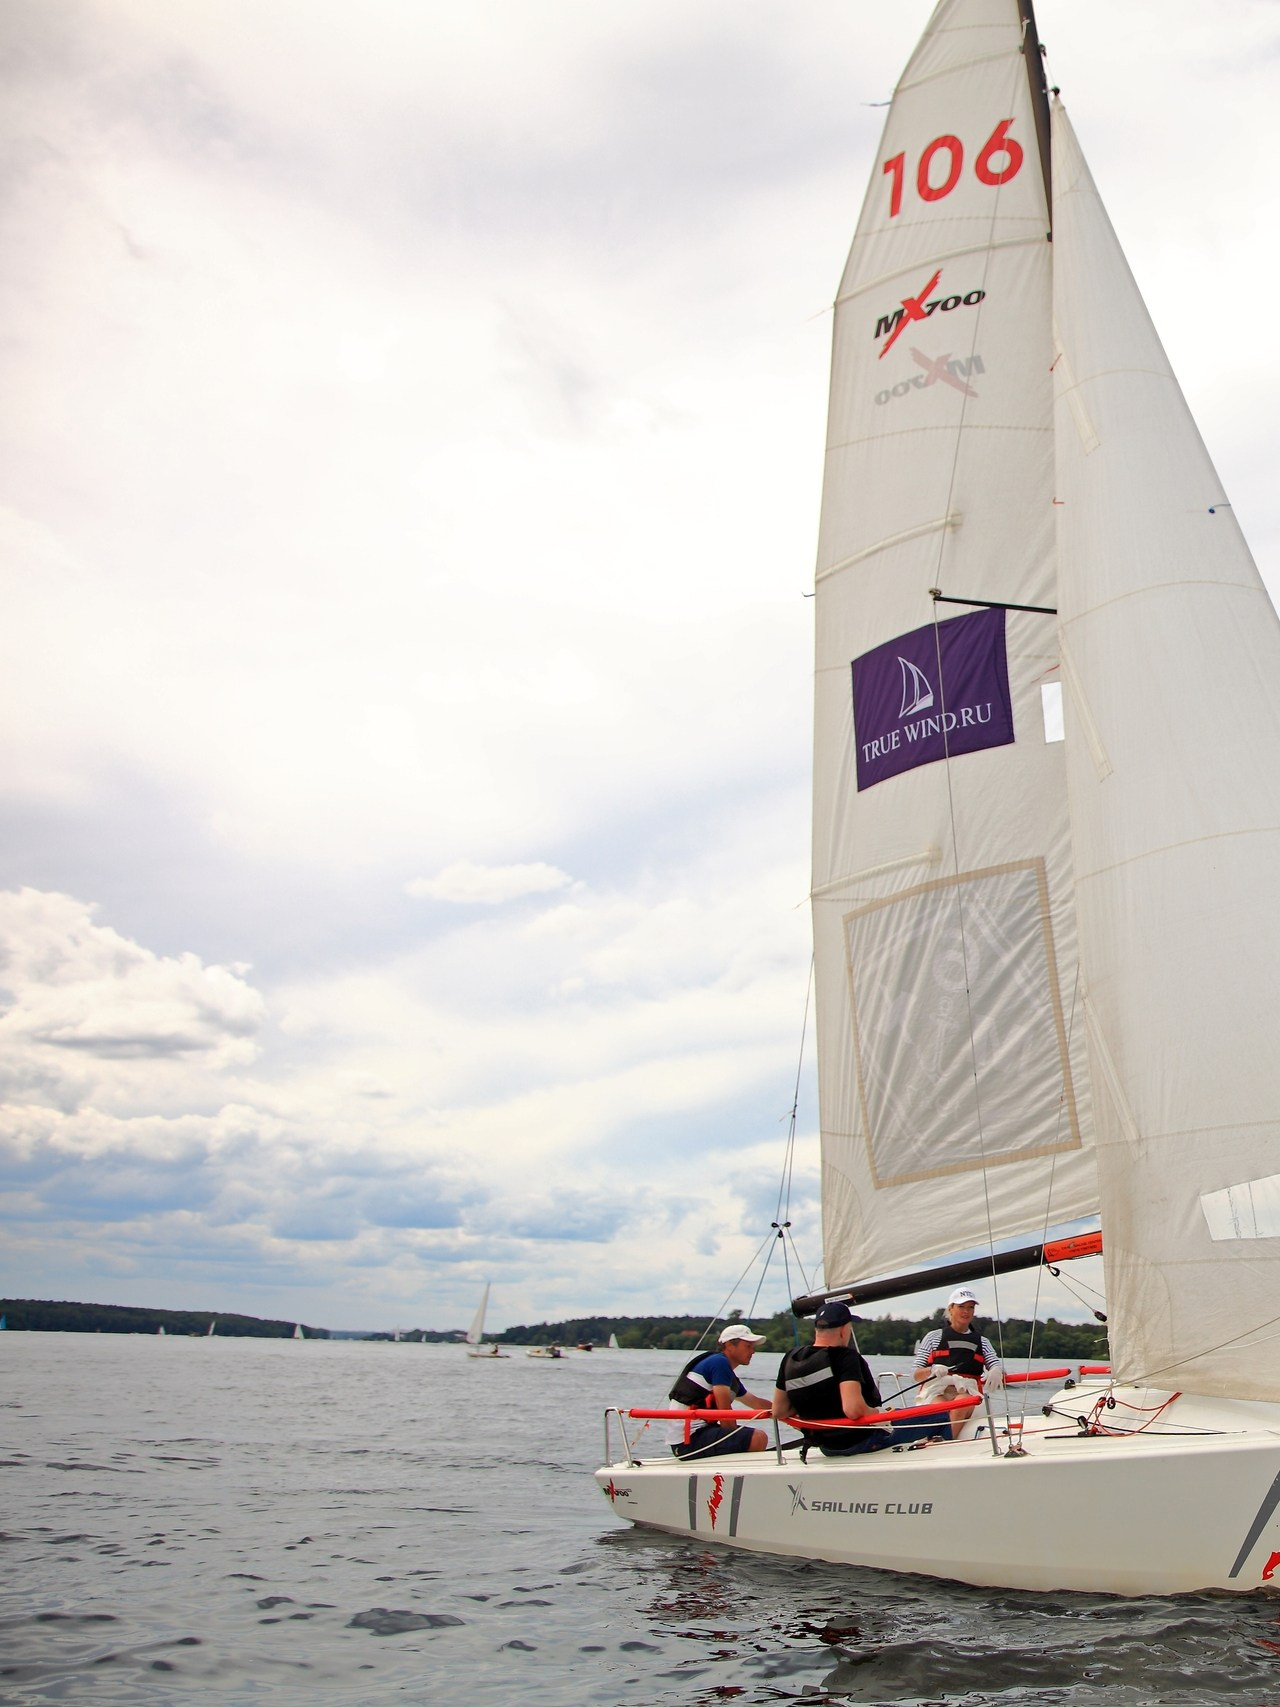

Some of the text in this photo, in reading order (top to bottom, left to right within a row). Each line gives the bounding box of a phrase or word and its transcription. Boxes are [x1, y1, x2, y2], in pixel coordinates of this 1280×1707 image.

[882, 117, 1024, 218] 106
[873, 268, 986, 360] MX700
[862, 702, 992, 763] TRUE WIND.RU
[811, 1500, 879, 1514] SAILING
[884, 1502, 934, 1515] CLUB
